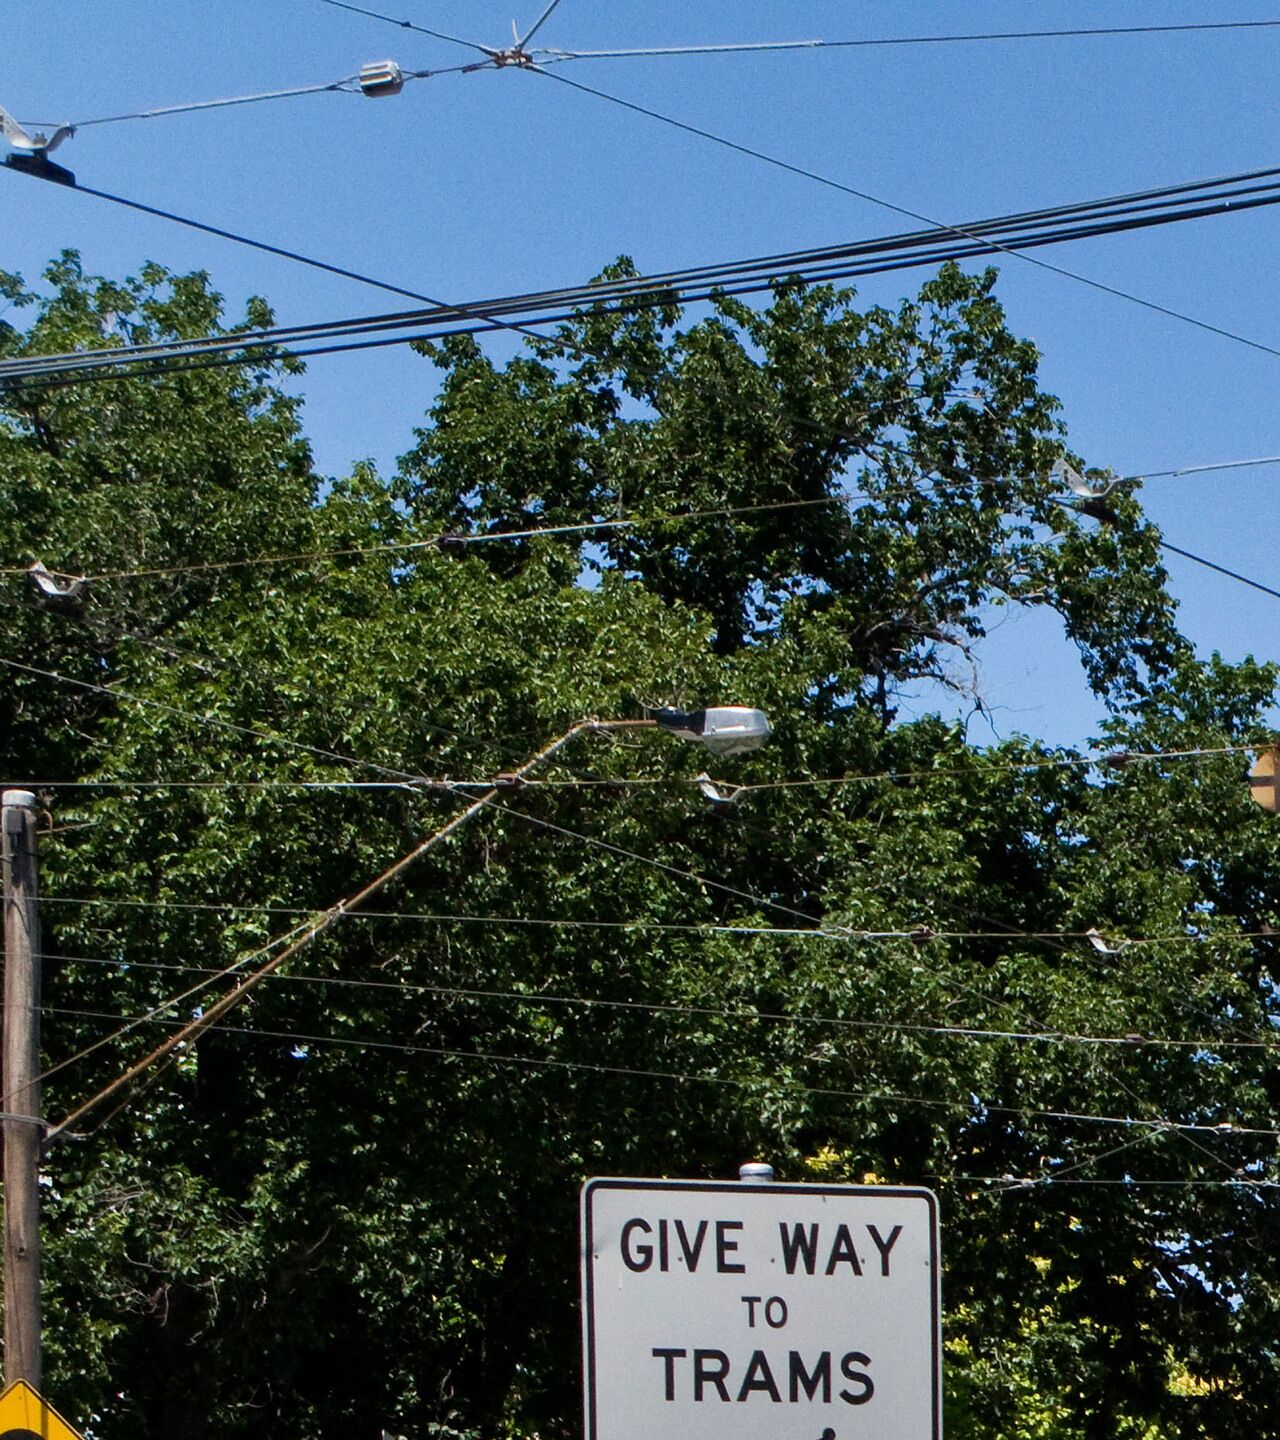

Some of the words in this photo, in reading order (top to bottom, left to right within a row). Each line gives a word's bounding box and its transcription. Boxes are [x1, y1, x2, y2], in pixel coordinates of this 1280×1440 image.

[619, 1217, 746, 1274] GIVE
[779, 1222, 904, 1277] WAY
[741, 1295, 788, 1329] TO
[652, 1348, 875, 1405] TRAMS
